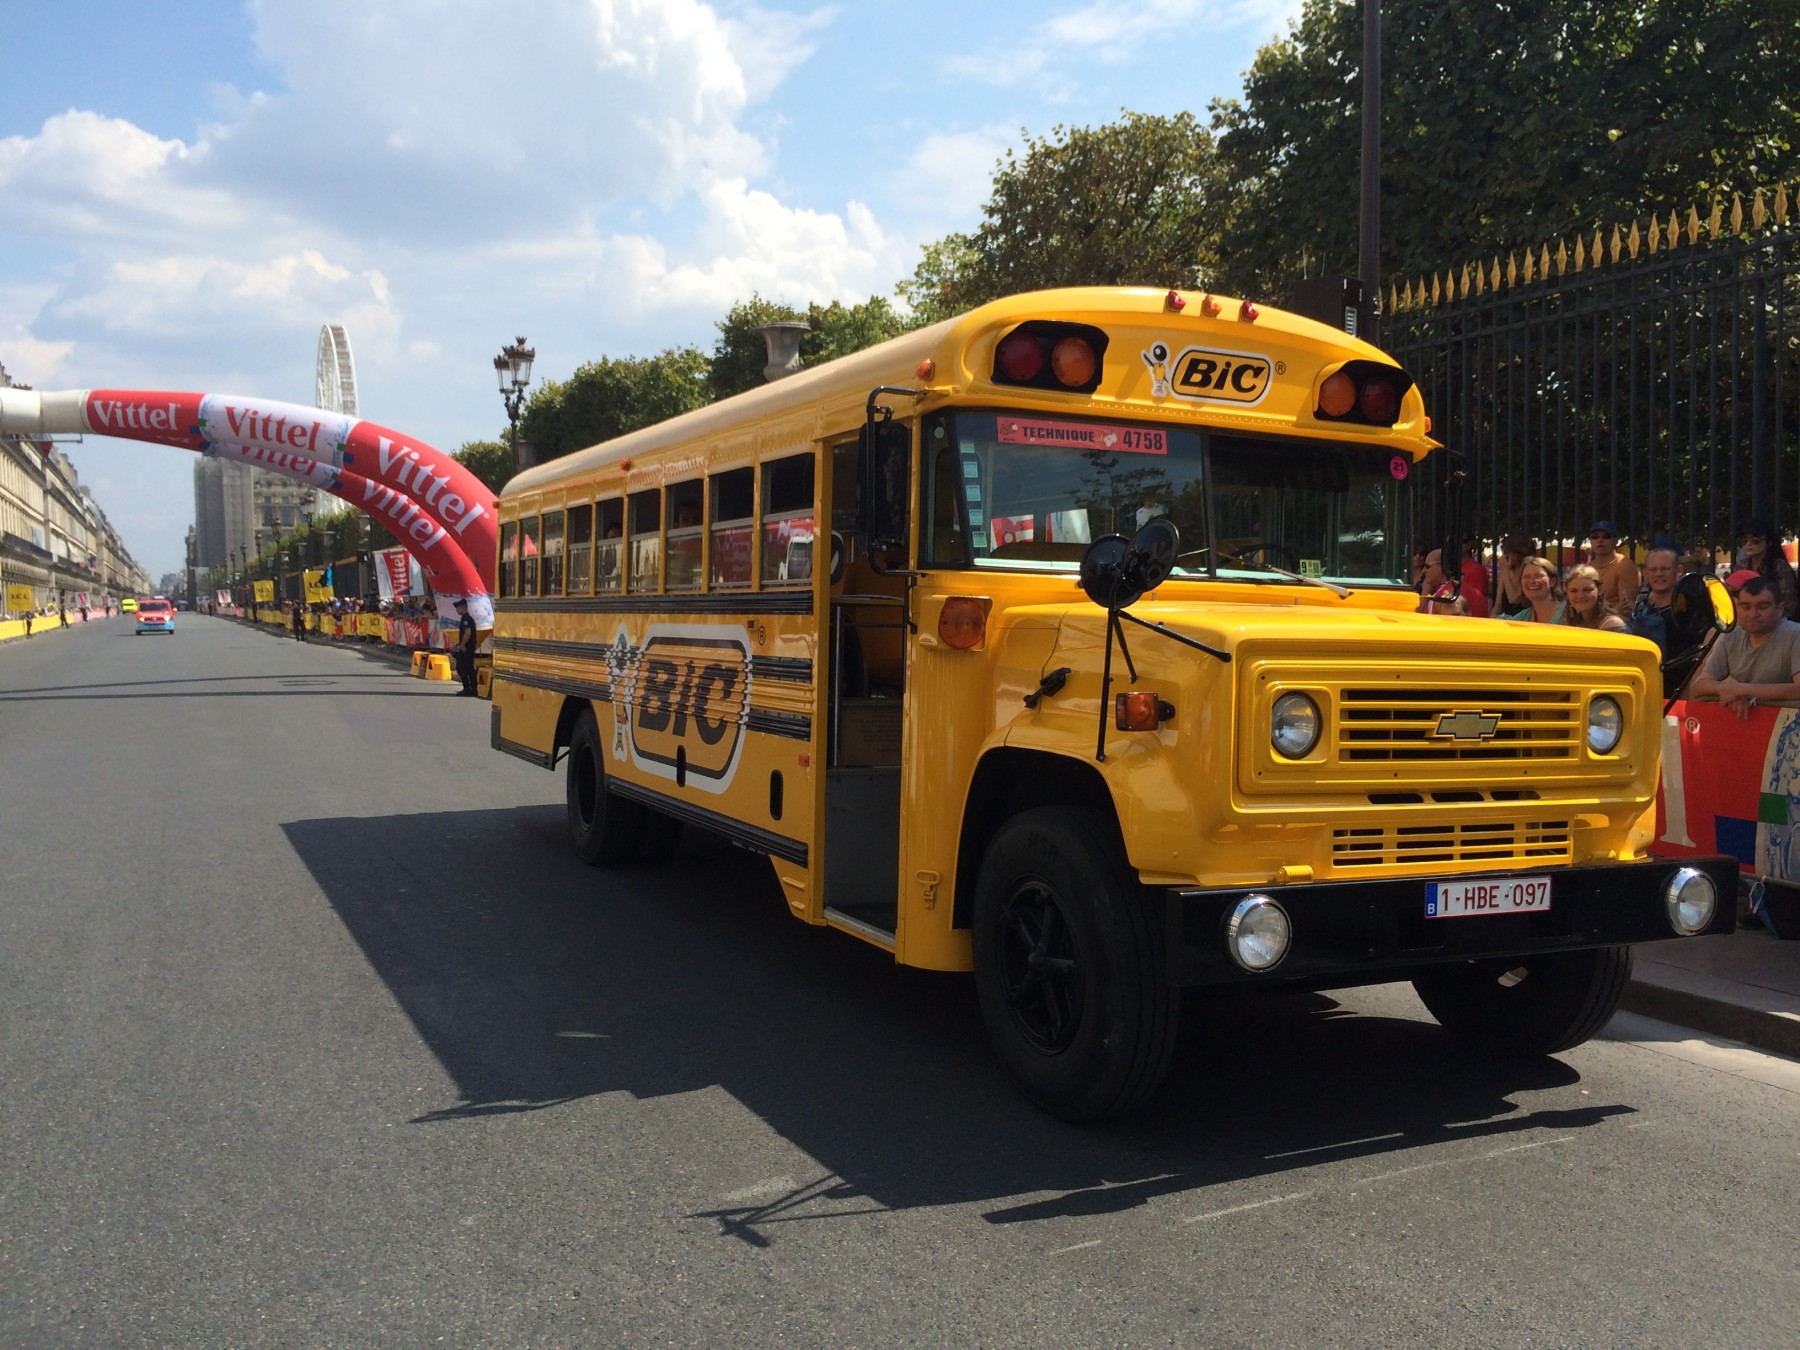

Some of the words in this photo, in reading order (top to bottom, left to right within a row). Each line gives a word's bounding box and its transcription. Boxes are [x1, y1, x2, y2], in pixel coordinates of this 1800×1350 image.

[1179, 357, 1266, 393] BiC
[92, 400, 179, 430] Vittel
[224, 406, 321, 452] Vittel
[1021, 426, 1096, 443] TECHNIQUE
[1122, 430, 1163, 451] 4758
[377, 435, 486, 537] Vittel
[363, 478, 448, 551] Vittel
[390, 553, 407, 595] Vittel
[638, 659, 739, 746] BiC
[1427, 903, 1435, 914] B
[1441, 883, 1548, 911] 1-HBE-097
